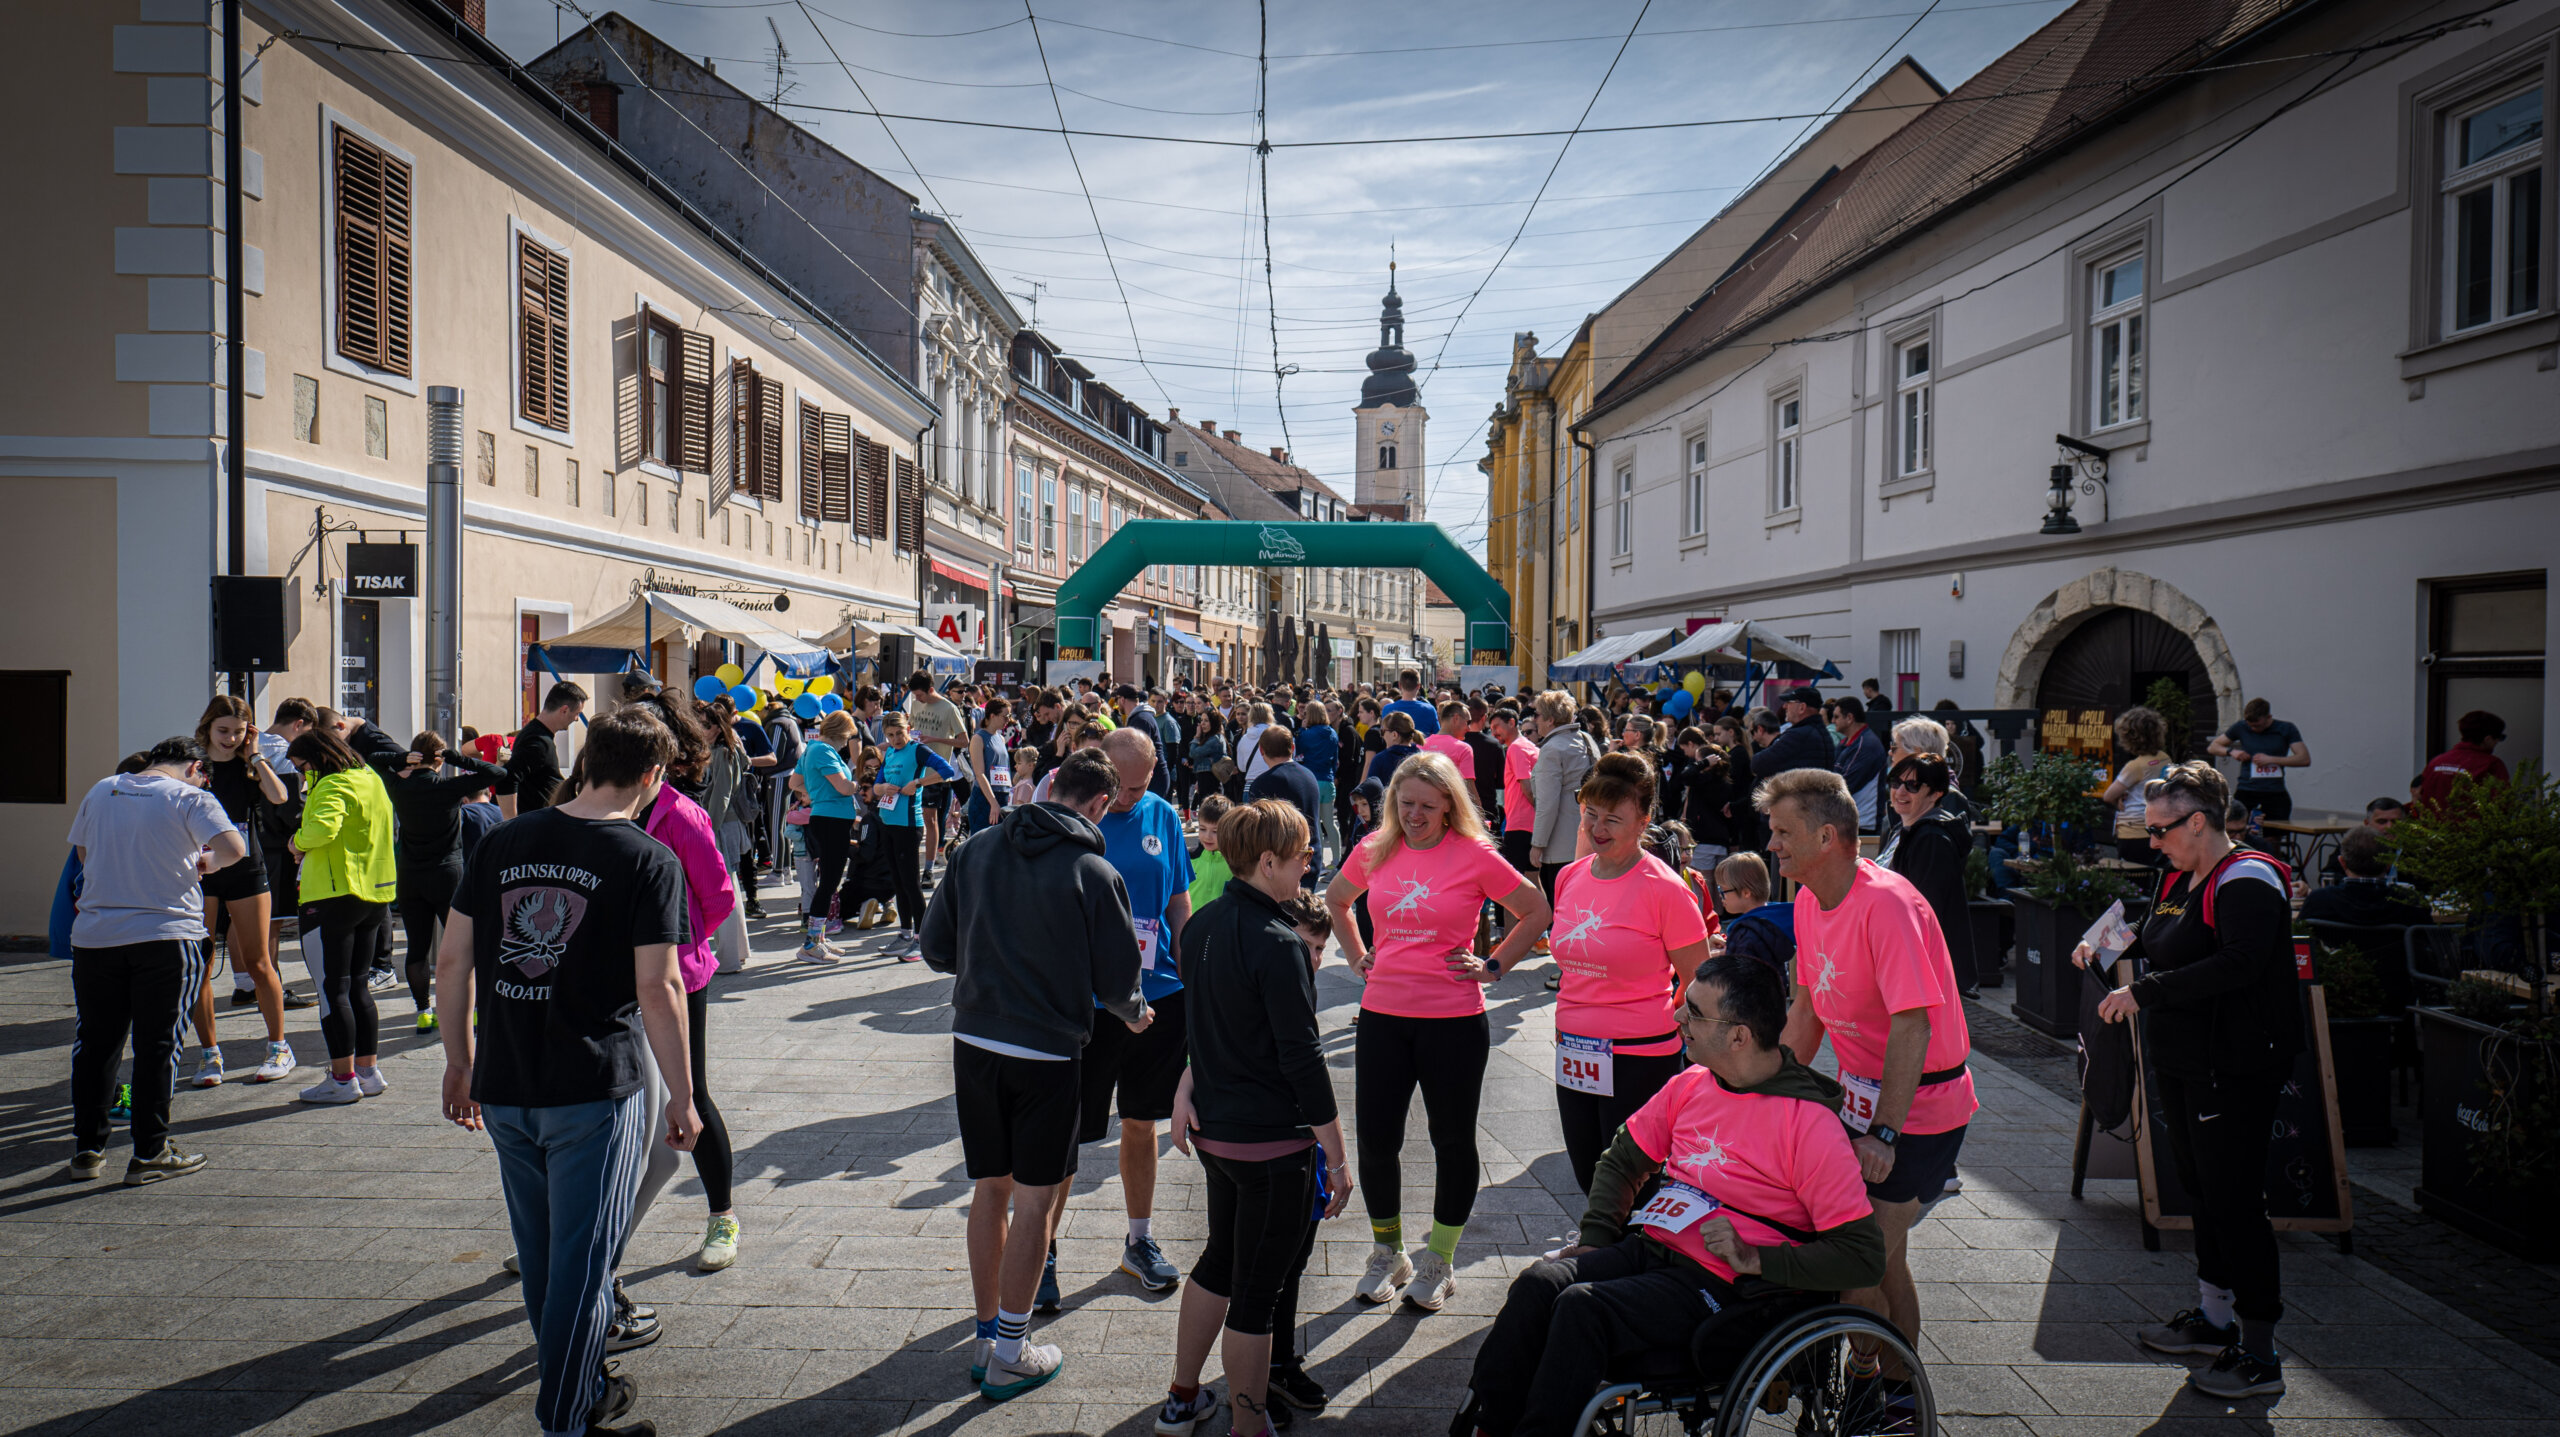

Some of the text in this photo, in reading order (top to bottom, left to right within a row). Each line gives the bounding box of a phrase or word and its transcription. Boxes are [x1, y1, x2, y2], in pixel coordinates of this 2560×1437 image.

[354, 575, 406, 589] TISAK
[937, 610, 967, 643] A1
[342, 658, 356, 666] CCO
[2042, 723, 2076, 737] MARATON
[2076, 724, 2113, 739] MARATON
[994, 773, 1008, 782] 281
[500, 864, 602, 891] ZRINSKI OPEN
[1576, 968, 1608, 978] SUBOTICA
[495, 979, 552, 1000] CROATI
[1562, 1056, 1600, 1082] 214
[1645, 1197, 1691, 1218] 216
